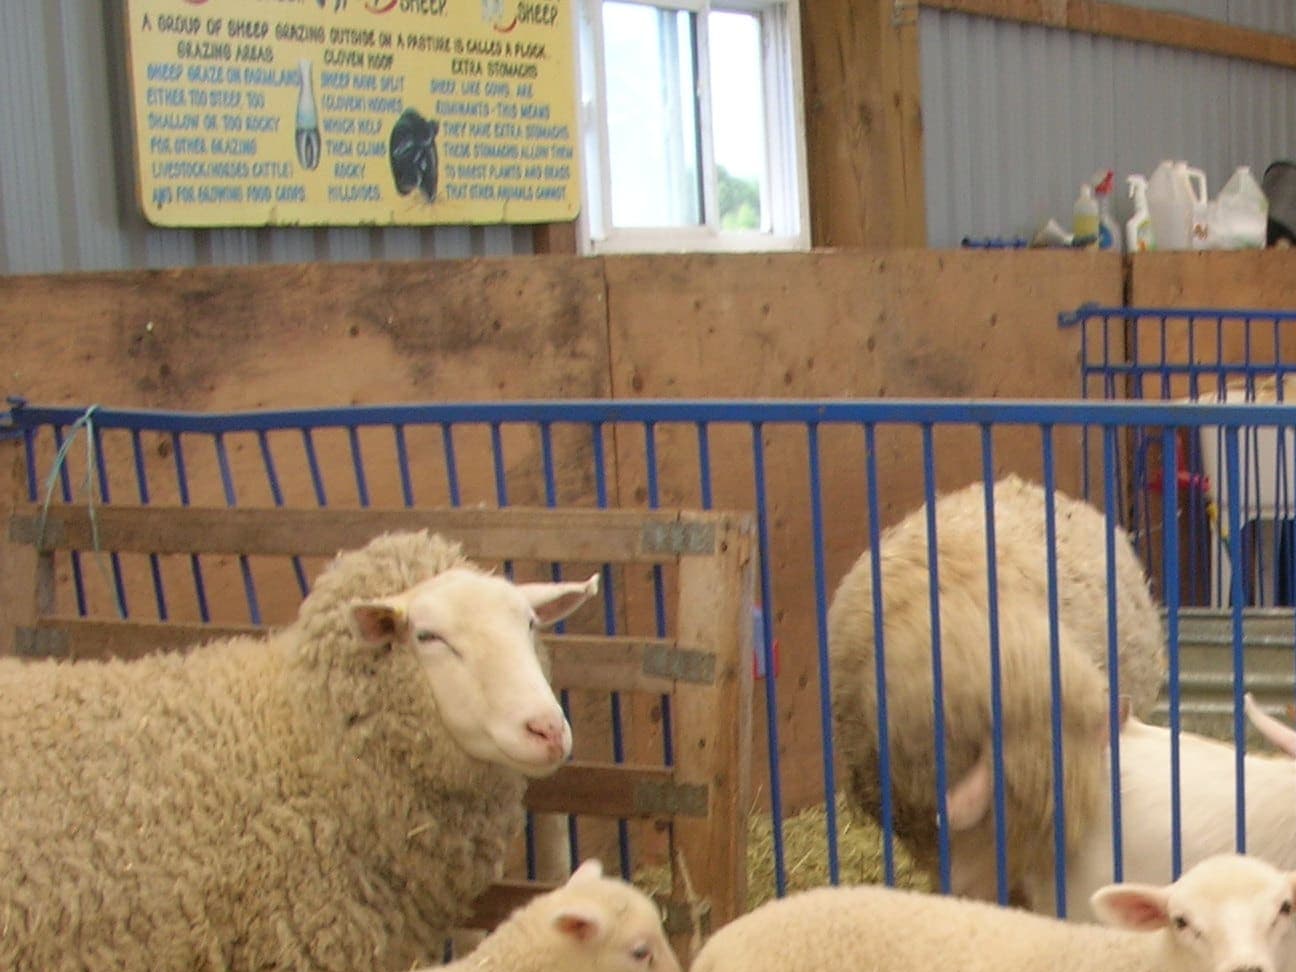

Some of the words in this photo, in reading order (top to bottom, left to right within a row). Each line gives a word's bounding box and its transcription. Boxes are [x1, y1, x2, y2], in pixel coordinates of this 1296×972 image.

[141, 13, 152, 32] A
[158, 14, 200, 35] GROUP
[207, 17, 222, 36] OF
[228, 19, 268, 38] SHEEP
[275, 22, 325, 43] GRAZING
[330, 26, 375, 47] OUTSIDE
[379, 31, 392, 47] ON
[407, 33, 450, 52] PASTURE
[466, 38, 502, 55] CALLED
[177, 40, 231, 60] GRAZING
[235, 43, 274, 62] AREAS
[323, 49, 364, 67] CLOVEN
[367, 52, 393, 69] HOOF
[147, 63, 182, 81] SHEEP
[188, 65, 224, 83] GRAZE
[451, 58, 482, 76] EXTRA
[487, 60, 538, 79] STOMACHS
[321, 71, 350, 89] SHEEP
[353, 75, 376, 90] HAVE
[380, 75, 404, 92] SPLIT
[430, 80, 455, 94] SHEEP
[461, 82, 480, 95] LIKE
[516, 84, 533, 98] ARE
[147, 87, 184, 106] EITHER
[189, 89, 207, 106] TOO
[246, 91, 265, 108] TOO
[436, 101, 489, 117] RUMINANTS
[520, 104, 550, 120] MEANS
[148, 111, 199, 131] SHALLOW
[204, 114, 217, 130] OR
[222, 114, 242, 131] TOO
[245, 115, 280, 132] ROCKY
[323, 118, 355, 134] WHICH
[358, 119, 382, 134] HELP
[443, 122, 466, 137] THEY
[469, 123, 490, 138] HAVE
[494, 123, 521, 138] EXTRA
[151, 137, 170, 153] FOR
[175, 137, 206, 154] OTHER
[211, 137, 257, 155] GRAZING
[326, 139, 352, 156] THEM
[334, 163, 365, 179] ROCKY
